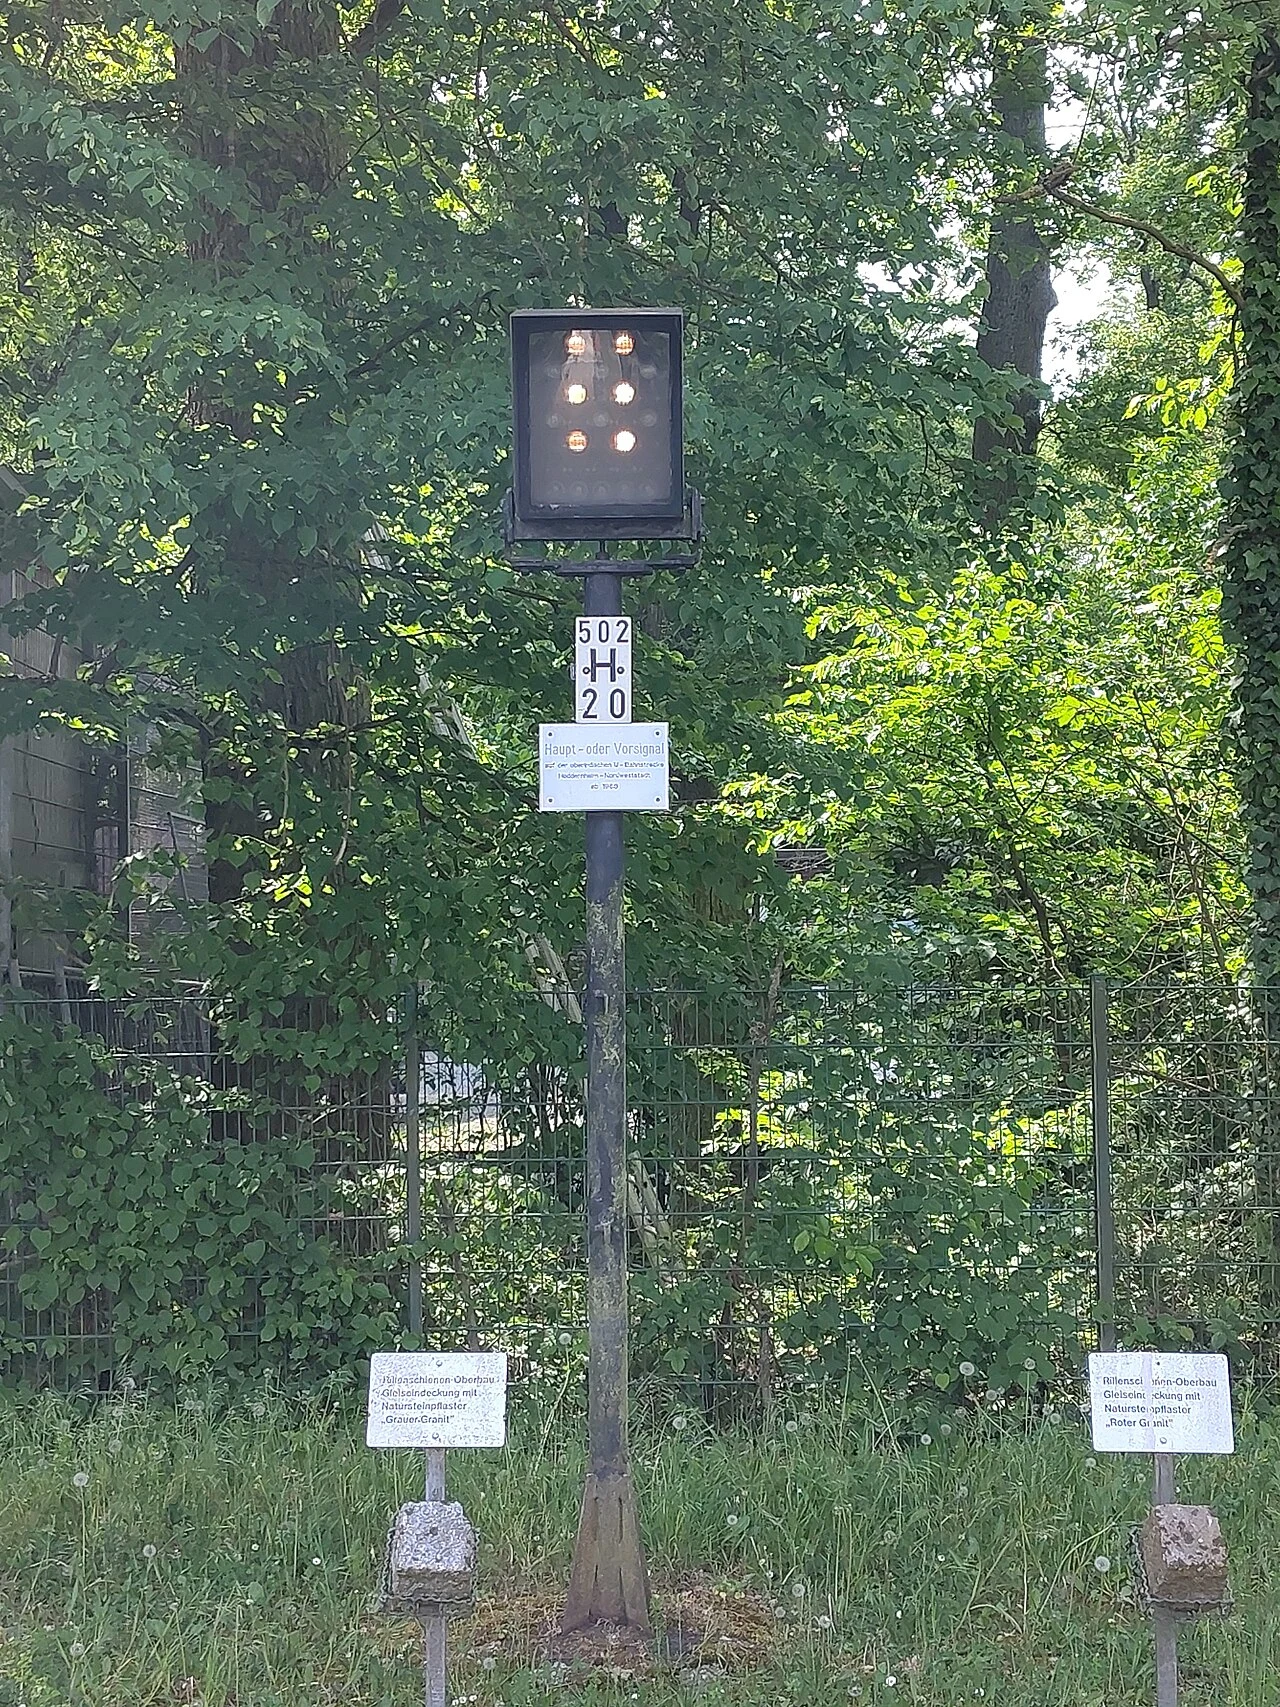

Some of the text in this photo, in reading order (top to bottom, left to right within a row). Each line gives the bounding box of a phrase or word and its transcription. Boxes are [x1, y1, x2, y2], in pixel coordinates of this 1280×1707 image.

[579, 620, 629, 643] 502
[582, 688, 625, 719] 20
[586, 743, 611, 755] oder
[613, 742, 665, 757] Vorsignal
[462, 1388, 478, 1398] mit
[1185, 1391, 1201, 1401] mit
[381, 1401, 468, 1411] Natursteinpflaster
